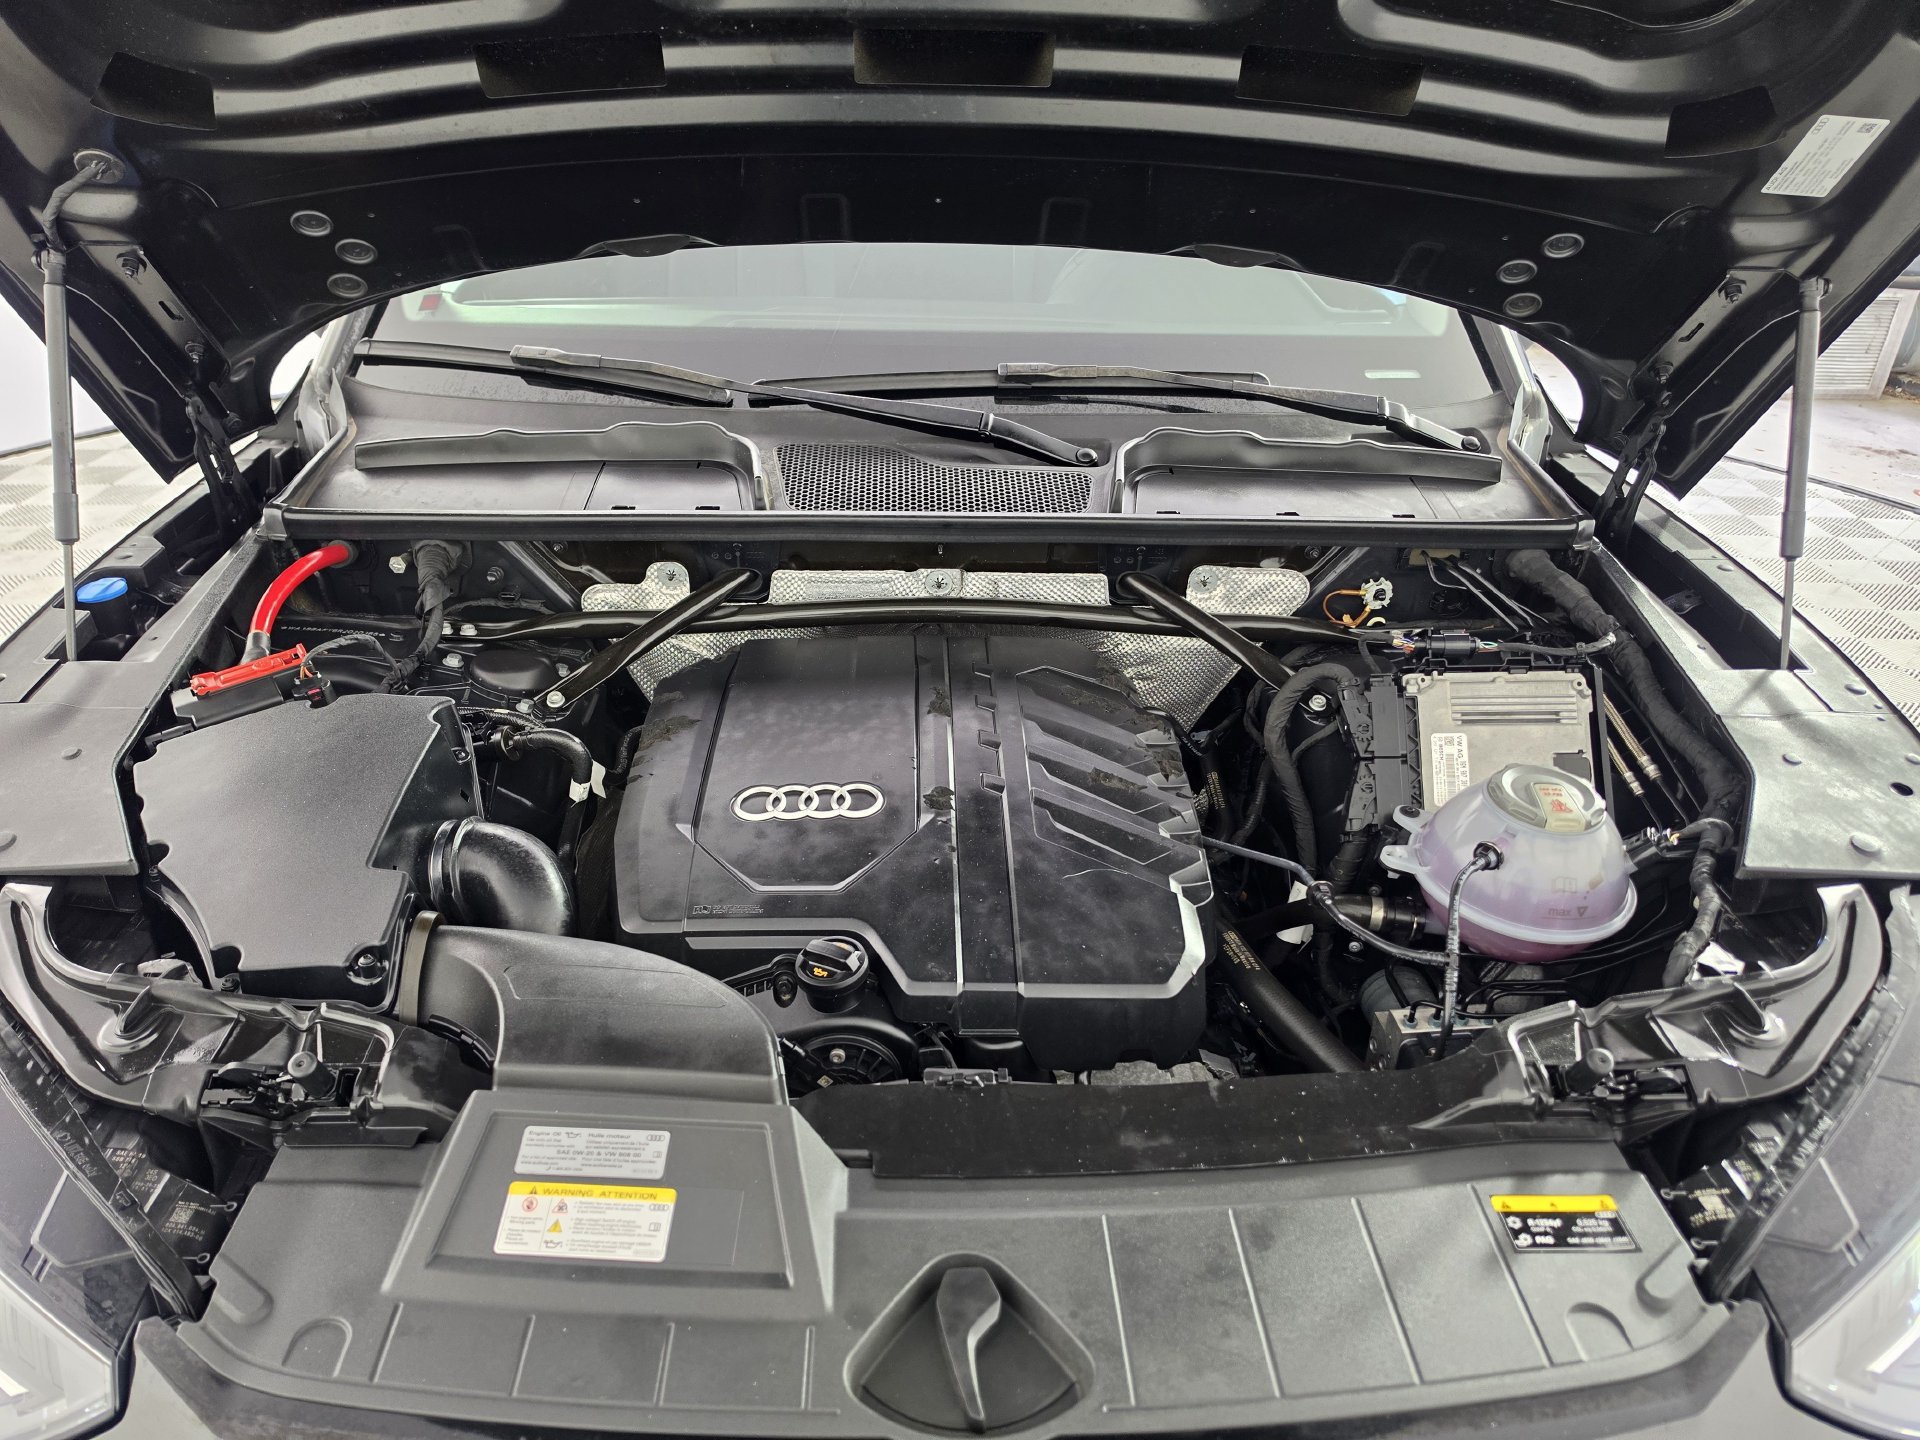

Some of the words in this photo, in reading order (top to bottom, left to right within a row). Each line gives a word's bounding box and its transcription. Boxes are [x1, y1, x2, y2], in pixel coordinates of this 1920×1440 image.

[1548, 907, 1571, 916] max
[543, 1188, 594, 1198] WARNING
[599, 1190, 658, 1200] ATTENTION
